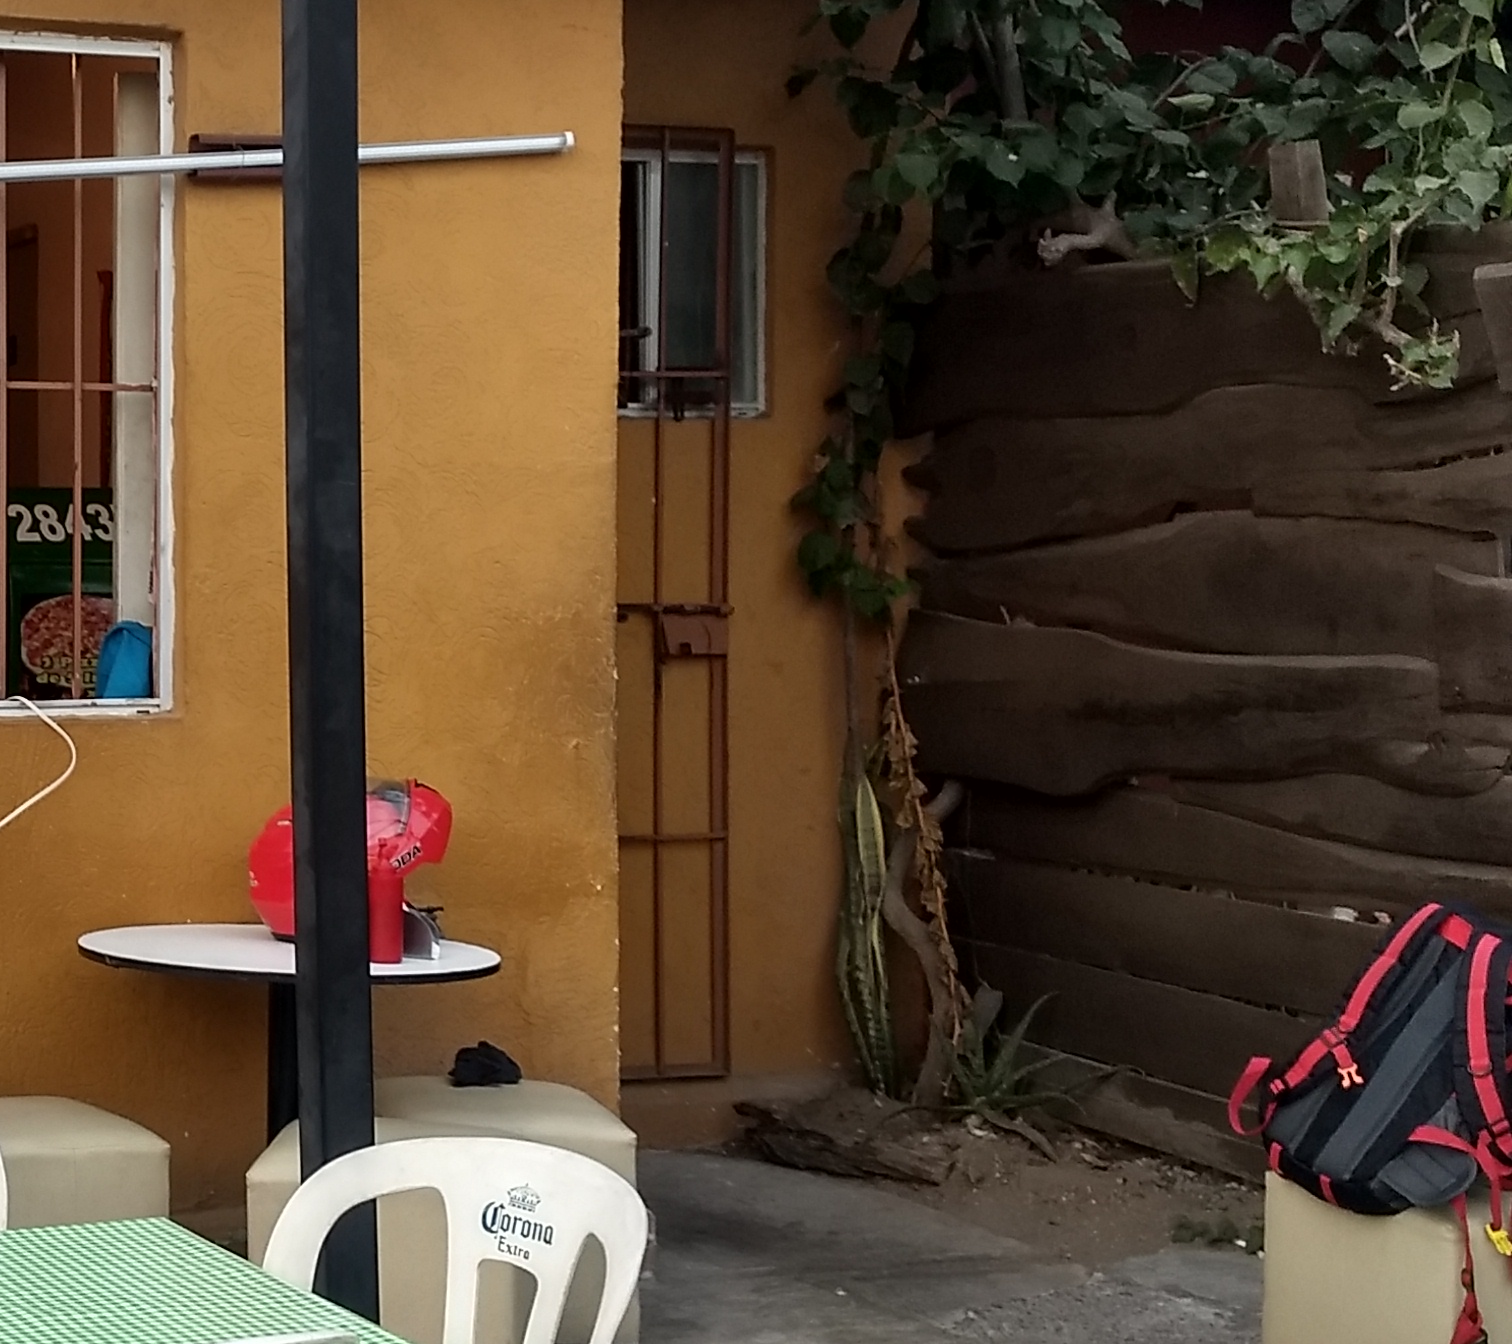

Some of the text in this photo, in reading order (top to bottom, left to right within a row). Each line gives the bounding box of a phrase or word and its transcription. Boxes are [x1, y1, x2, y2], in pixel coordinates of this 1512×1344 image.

[7, 503, 116, 543] 2843
[481, 1201, 554, 1245] Corona
[497, 1235, 531, 1260] Extra
